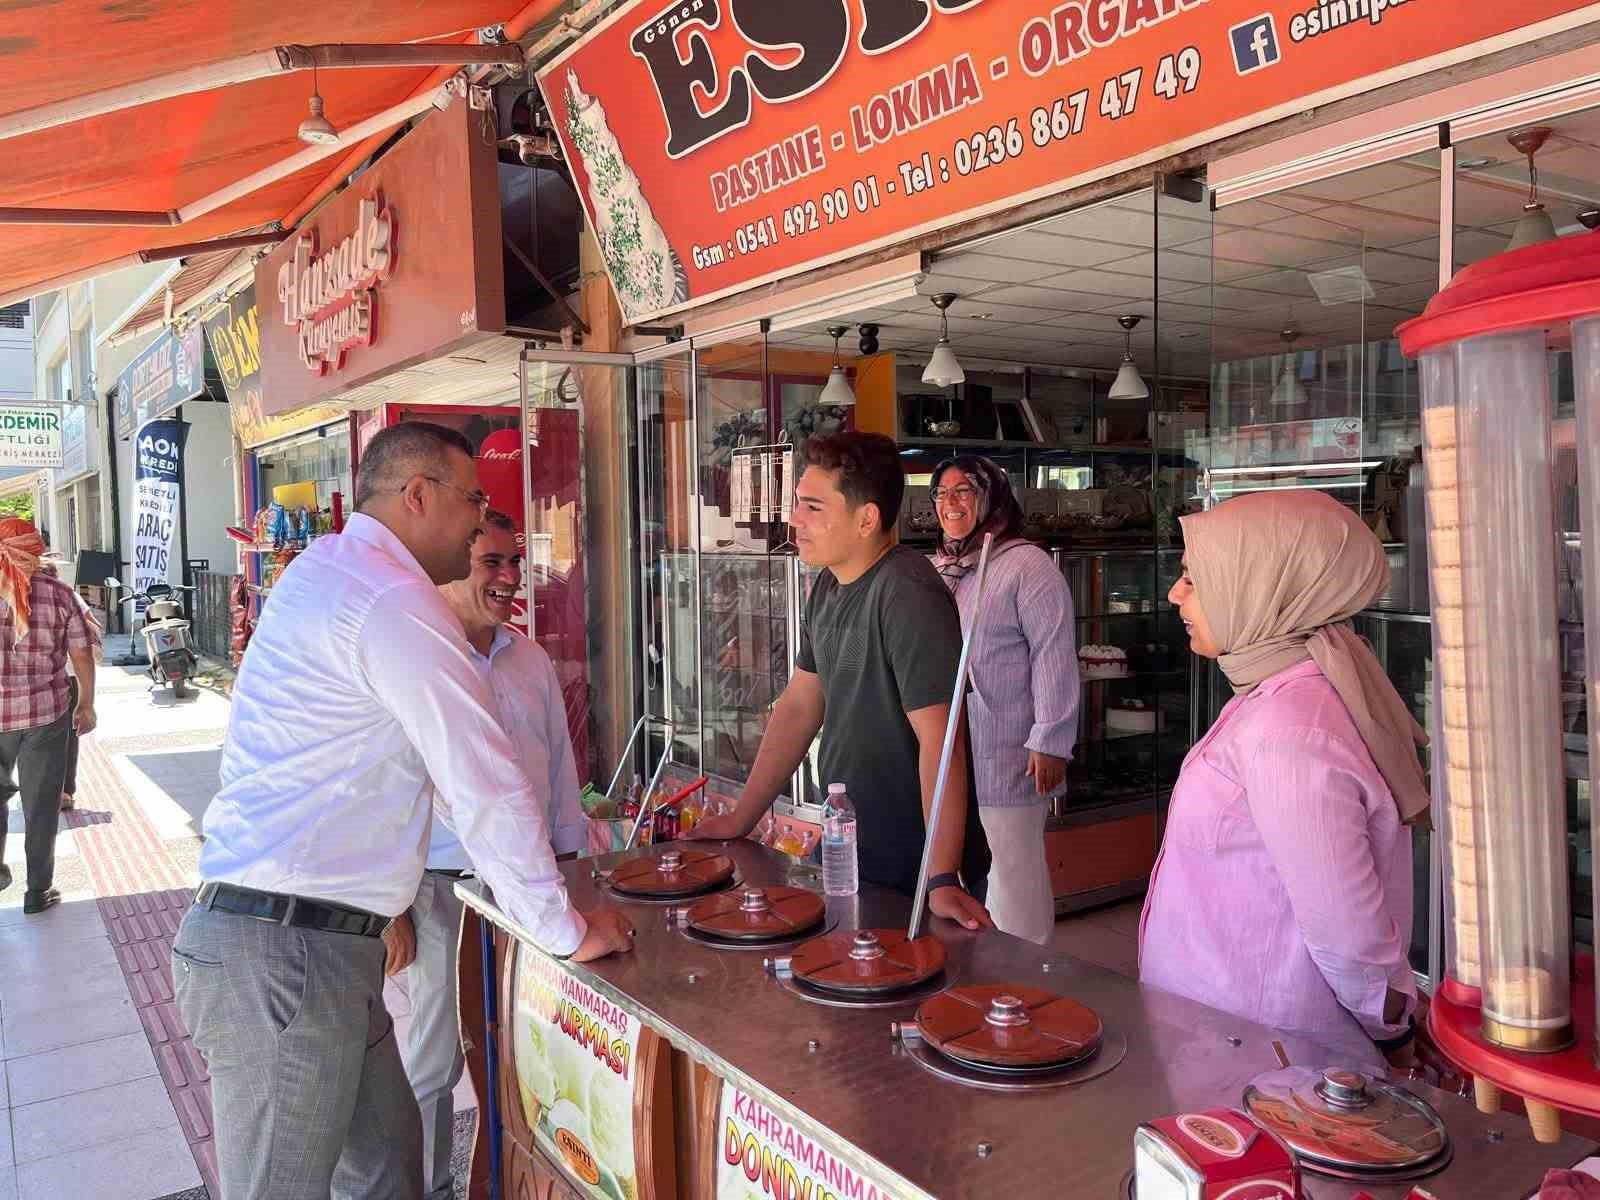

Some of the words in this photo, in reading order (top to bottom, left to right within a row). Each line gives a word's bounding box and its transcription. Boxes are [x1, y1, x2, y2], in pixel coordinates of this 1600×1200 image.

[644, 0, 704, 43] Gönen
[710, 124, 826, 213] PASTANE
[850, 53, 983, 153] LOKMA
[1019, 0, 1205, 77] ORGA
[692, 243, 725, 271] Gsm
[735, 216, 779, 254] 0541
[783, 200, 820, 238] 492
[821, 188, 849, 224] 90
[853, 174, 880, 212] 01
[898, 152, 935, 196] Tel
[954, 117, 1024, 176] 0236
[1030, 88, 1089, 147] 867
[1099, 67, 1143, 120] 47
[1153, 45, 1201, 100] 49
[137, 512, 171, 546] ARAÇ
[136, 544, 167, 577] SATIŞ
